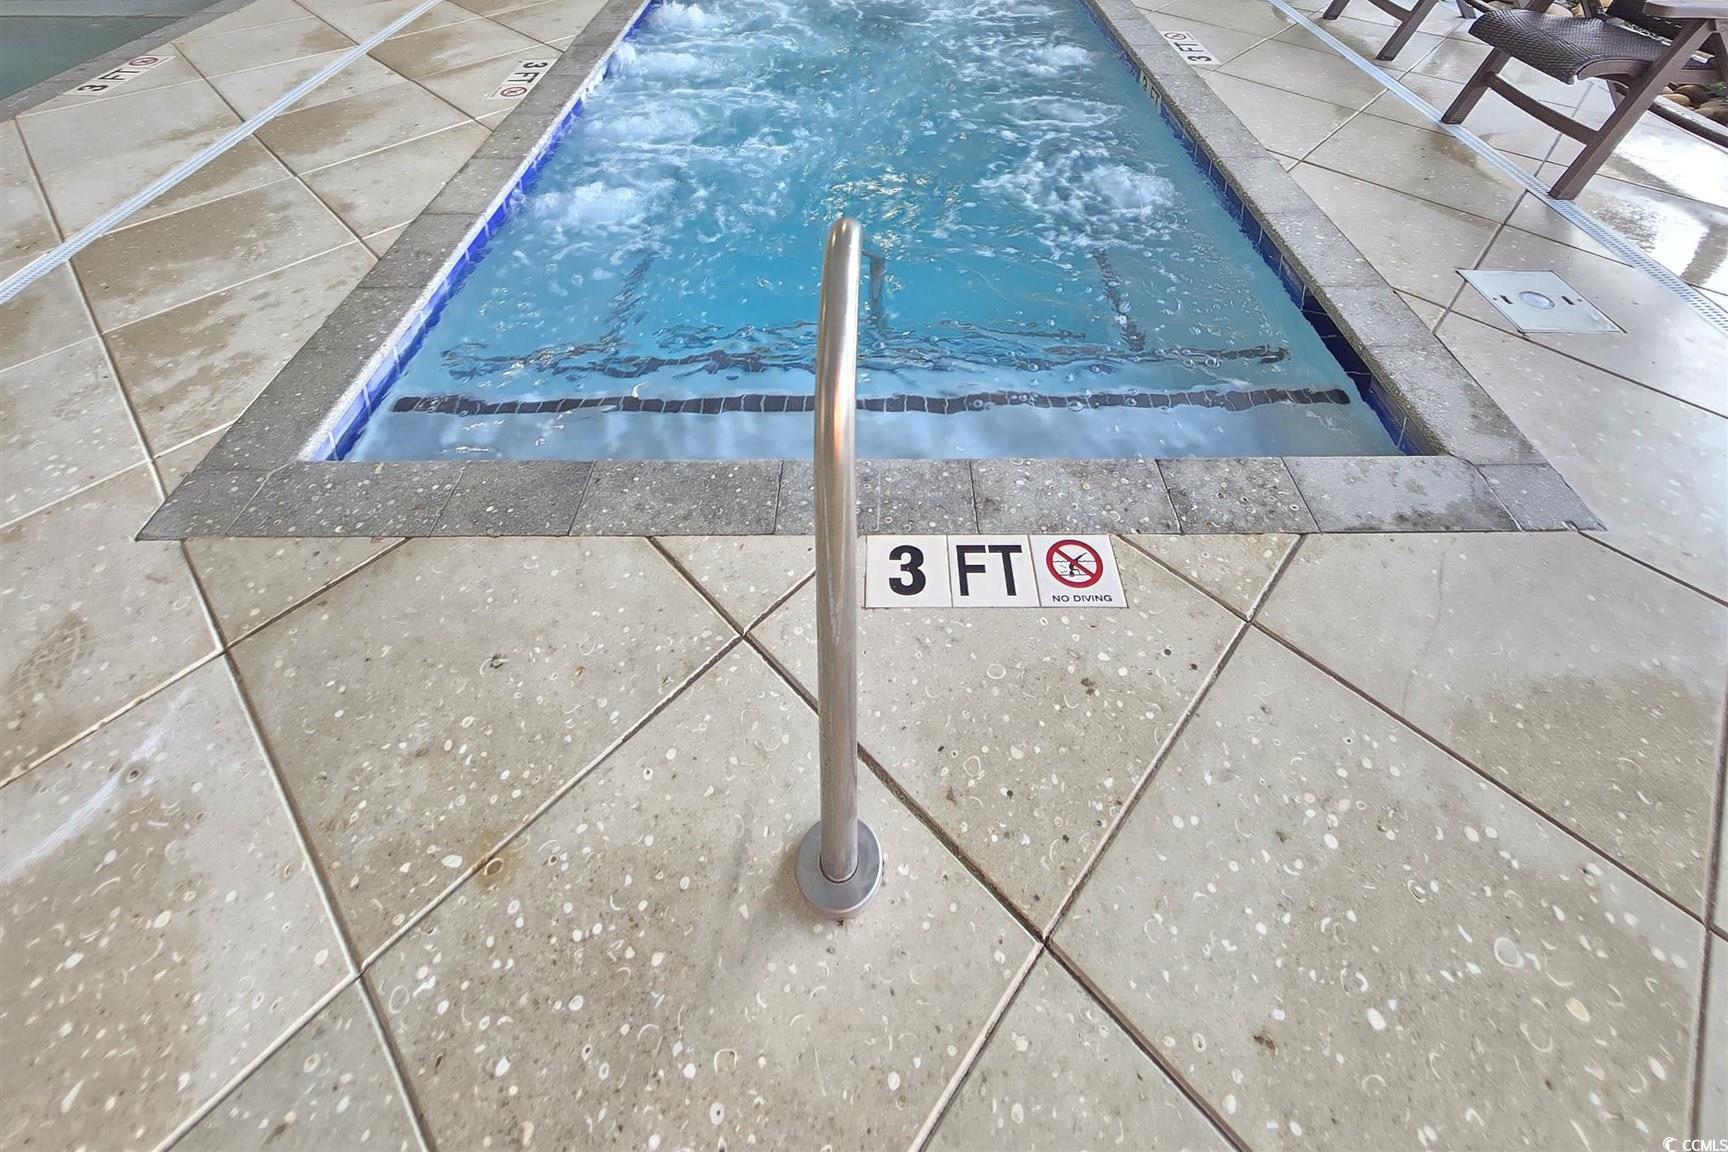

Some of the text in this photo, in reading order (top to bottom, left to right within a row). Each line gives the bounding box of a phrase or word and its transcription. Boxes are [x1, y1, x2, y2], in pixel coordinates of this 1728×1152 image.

[1174, 41, 1205, 52] FT
[77, 68, 141, 92] 3 FT
[507, 71, 540, 84] FT
[888, 544, 1023, 596] 3 FT
[1052, 594, 1113, 603] NO DIVING
